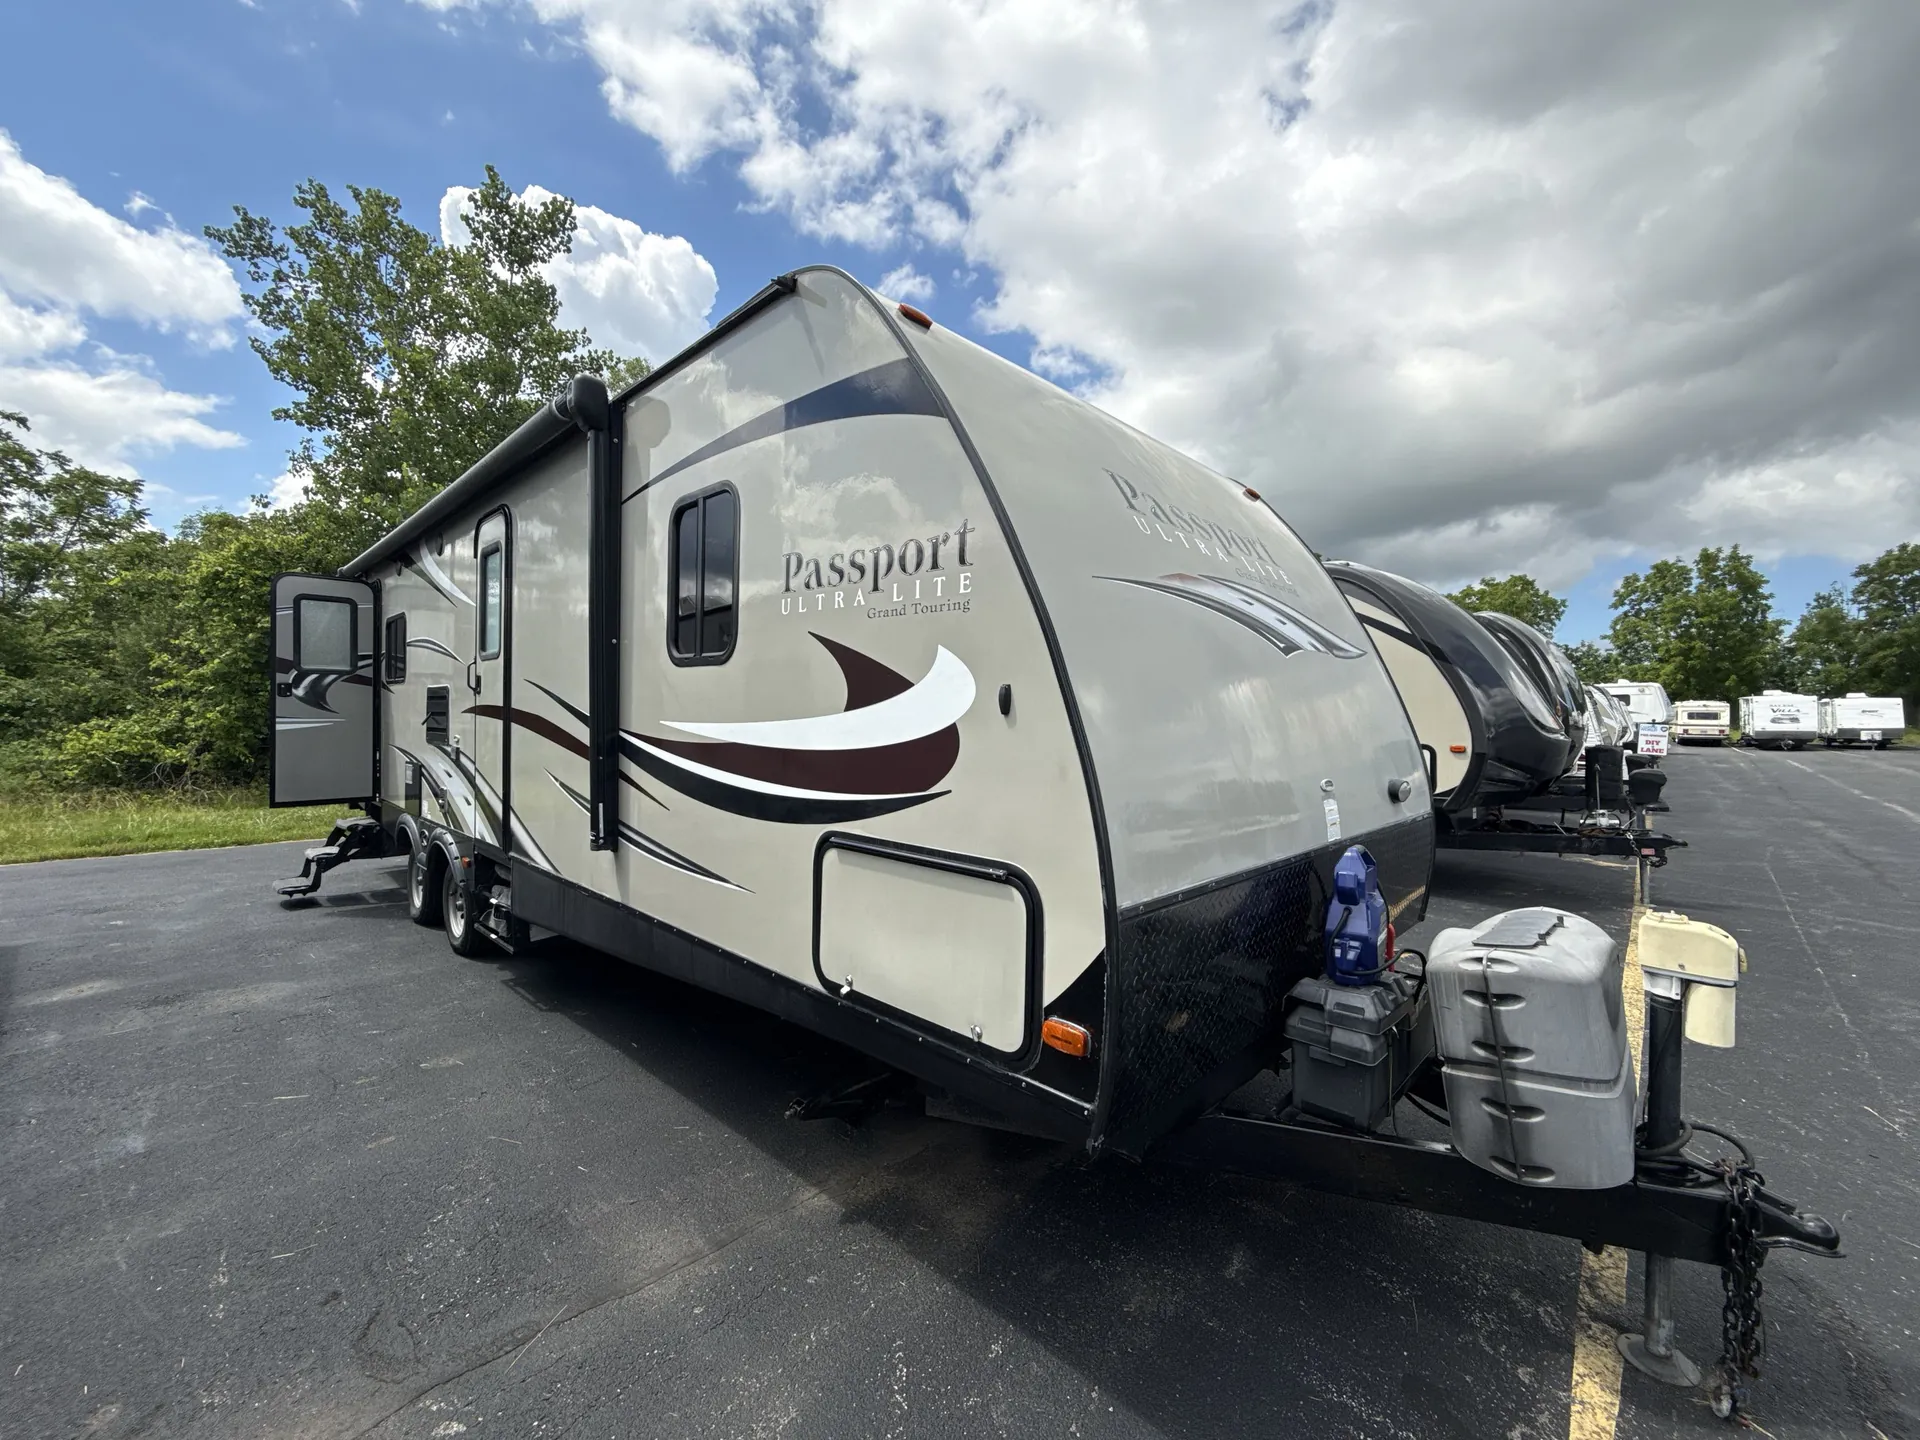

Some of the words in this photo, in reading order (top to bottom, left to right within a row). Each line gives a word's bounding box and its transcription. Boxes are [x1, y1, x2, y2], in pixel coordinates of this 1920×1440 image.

[1102, 467, 1282, 568] Passport
[1133, 515, 1229, 563] ULTRA
[1241, 556, 1293, 585] LITE
[781, 518, 975, 594] Passport
[781, 588, 865, 615] ULTRA
[892, 573, 972, 602] LITE
[867, 604, 907, 619] Grand
[911, 598, 971, 616] Touring
